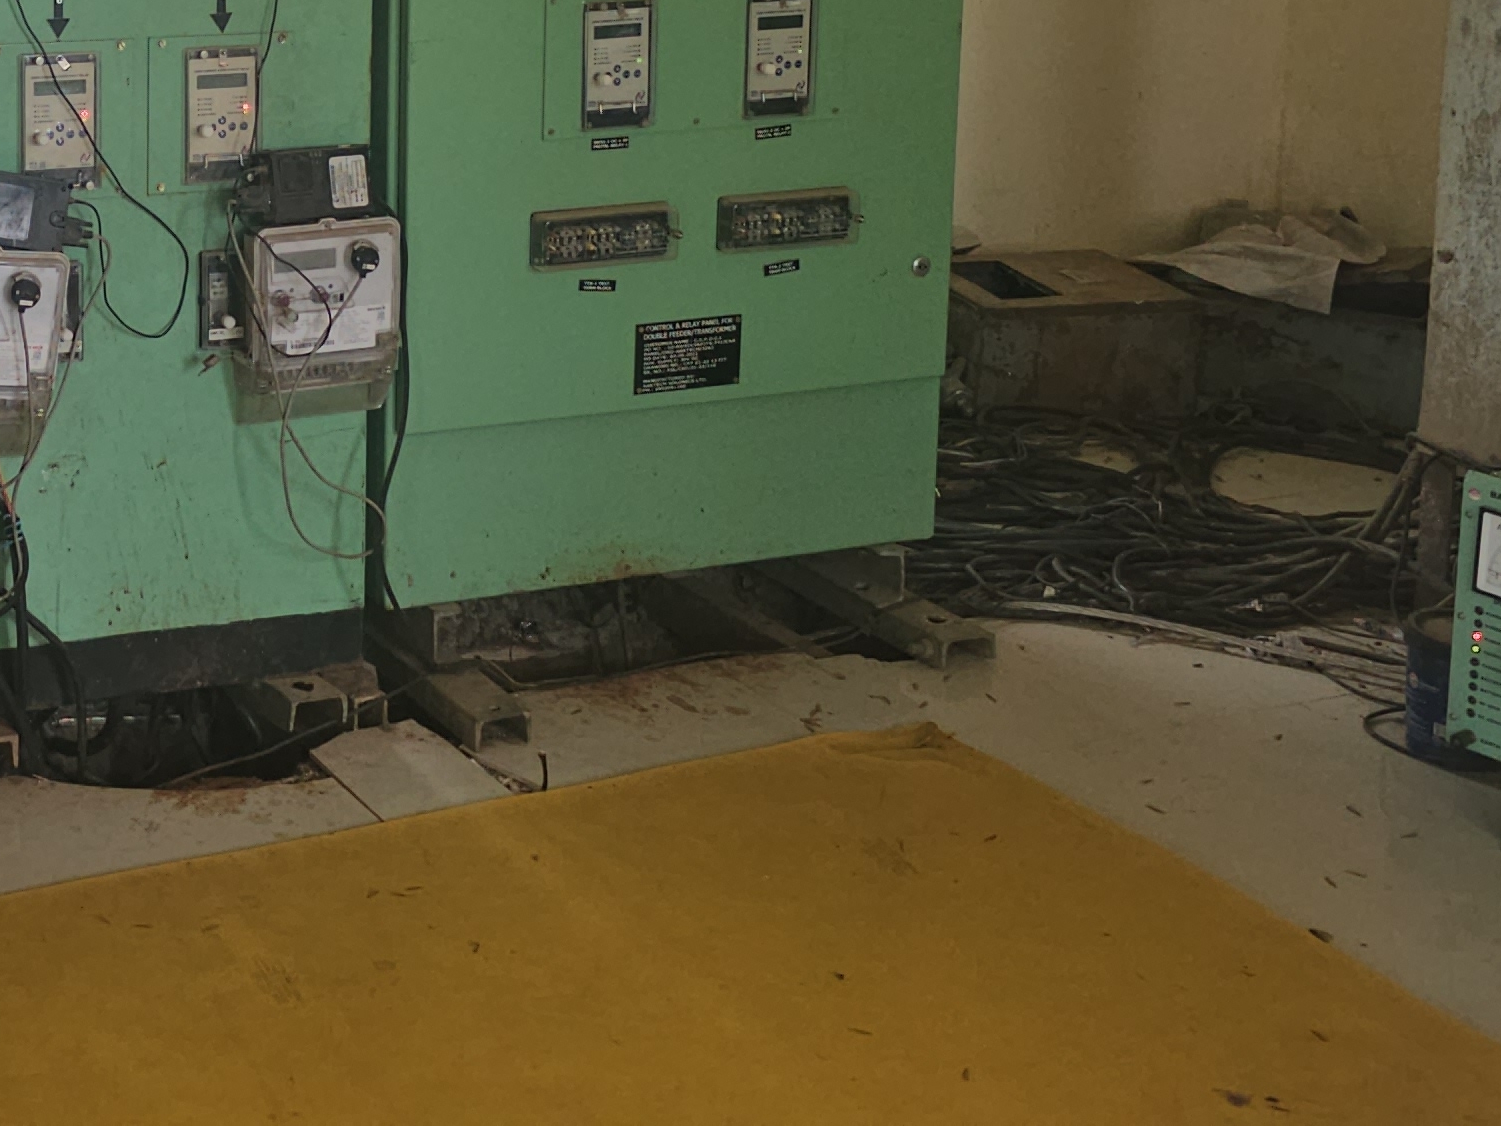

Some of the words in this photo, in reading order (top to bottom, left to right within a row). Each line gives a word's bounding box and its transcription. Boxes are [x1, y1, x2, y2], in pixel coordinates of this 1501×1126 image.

[645, 323, 674, 332] CONTROL
[681, 320, 701, 329] RELAY
[701, 318, 720, 326] PANEL
[643, 331, 668, 341] DOUBLE
